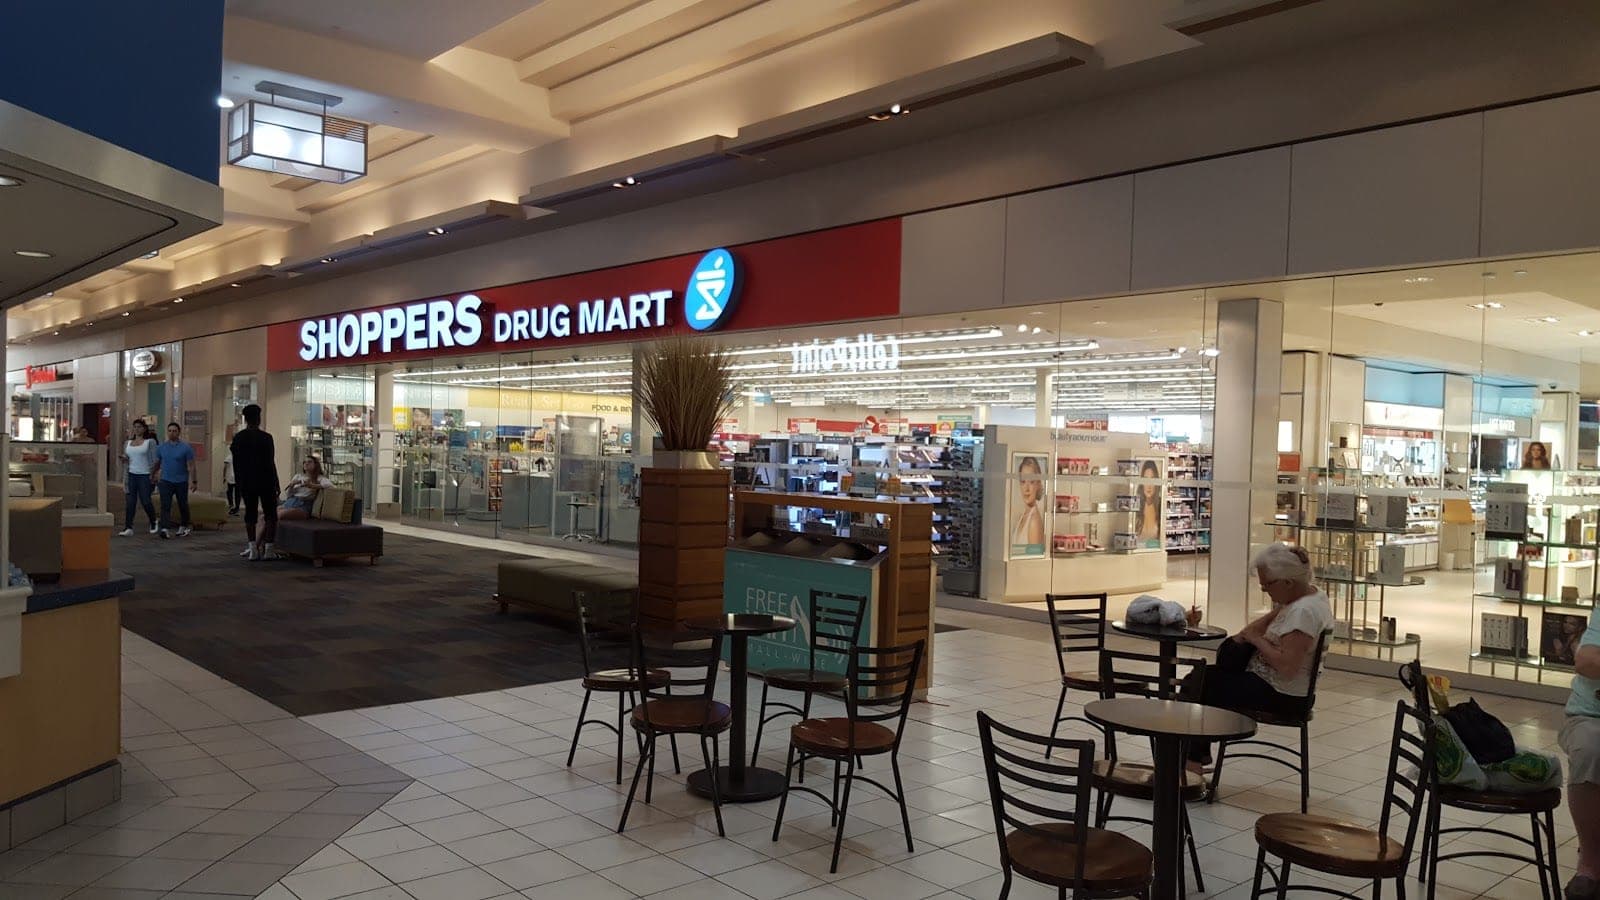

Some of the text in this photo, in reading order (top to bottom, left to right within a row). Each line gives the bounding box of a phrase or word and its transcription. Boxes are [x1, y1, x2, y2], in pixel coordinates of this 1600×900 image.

[299, 289, 673, 361] SHOPPERS DRUG MART
[591, 404, 612, 412] FOOD
[745, 587, 788, 616] FREE
